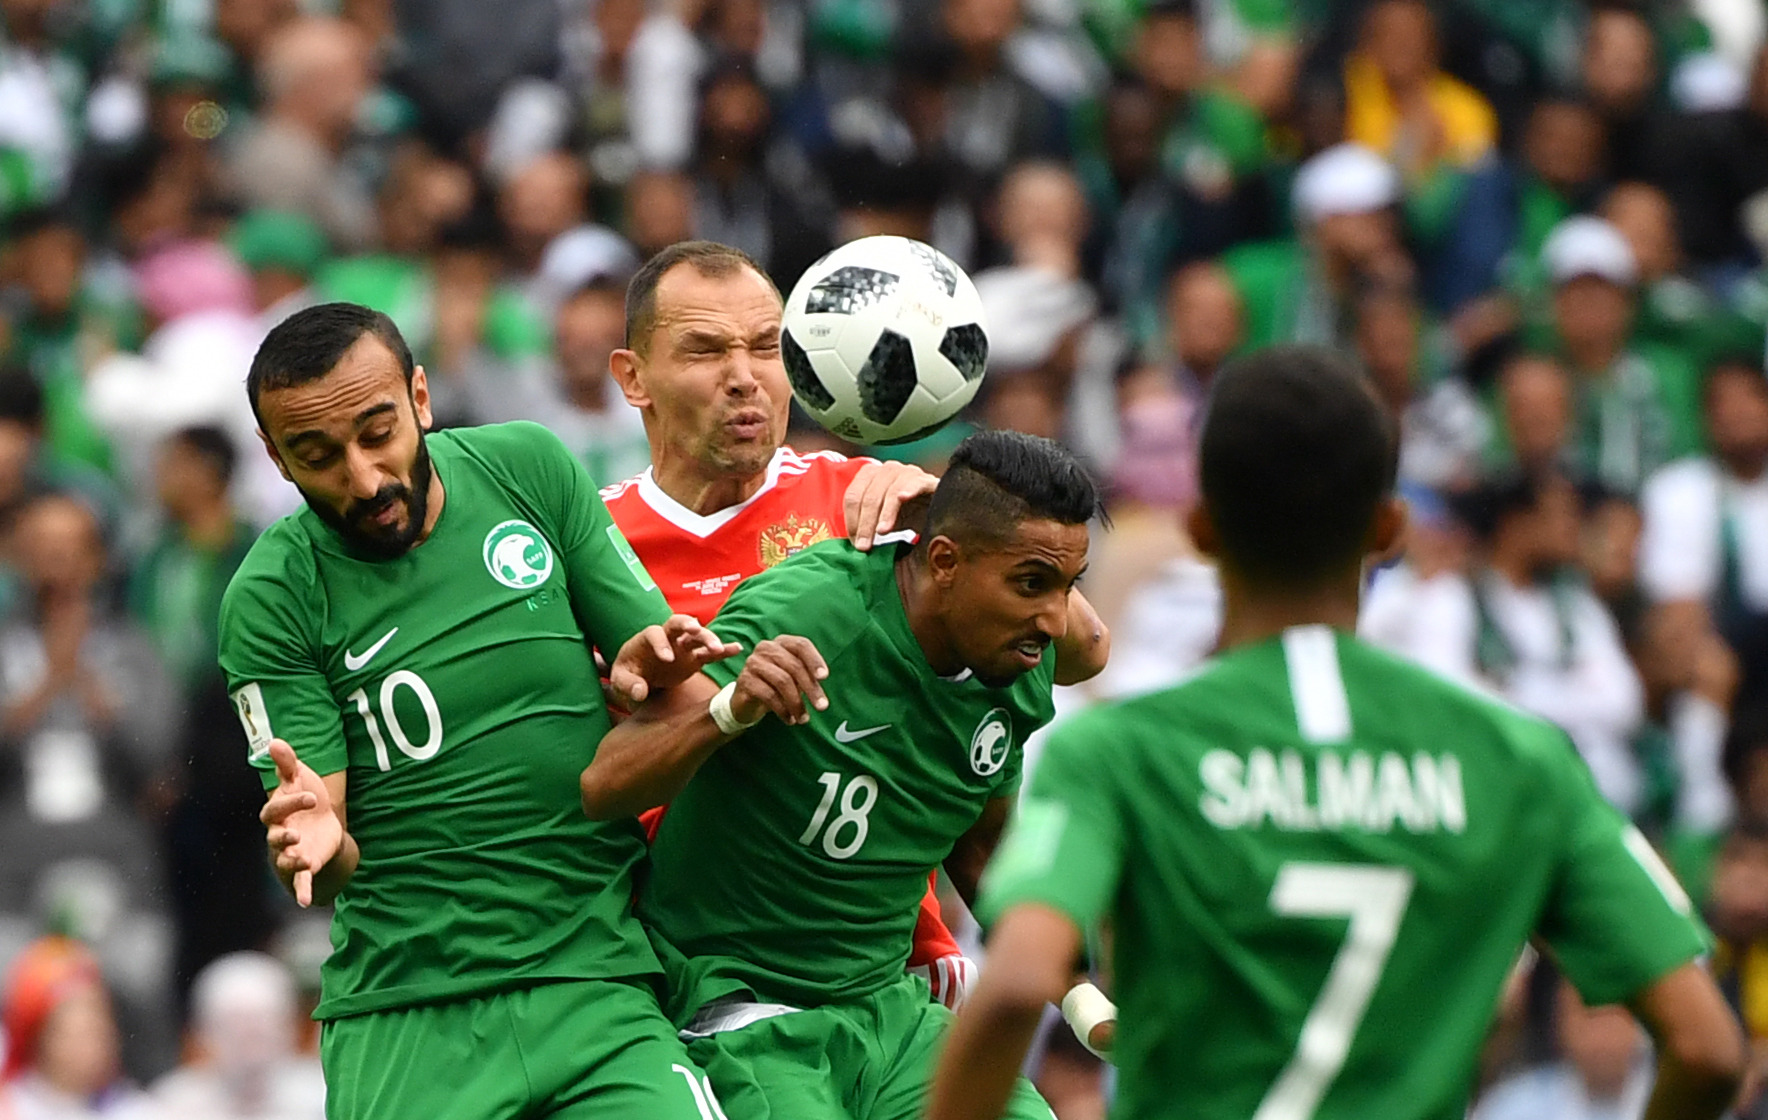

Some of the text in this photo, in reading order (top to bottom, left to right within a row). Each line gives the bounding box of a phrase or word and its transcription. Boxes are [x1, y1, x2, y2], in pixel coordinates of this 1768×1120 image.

[526, 589, 560, 612] KSA
[347, 670, 443, 772] 10
[799, 772, 878, 859] 18
[1199, 747, 1467, 834] SALMAN
